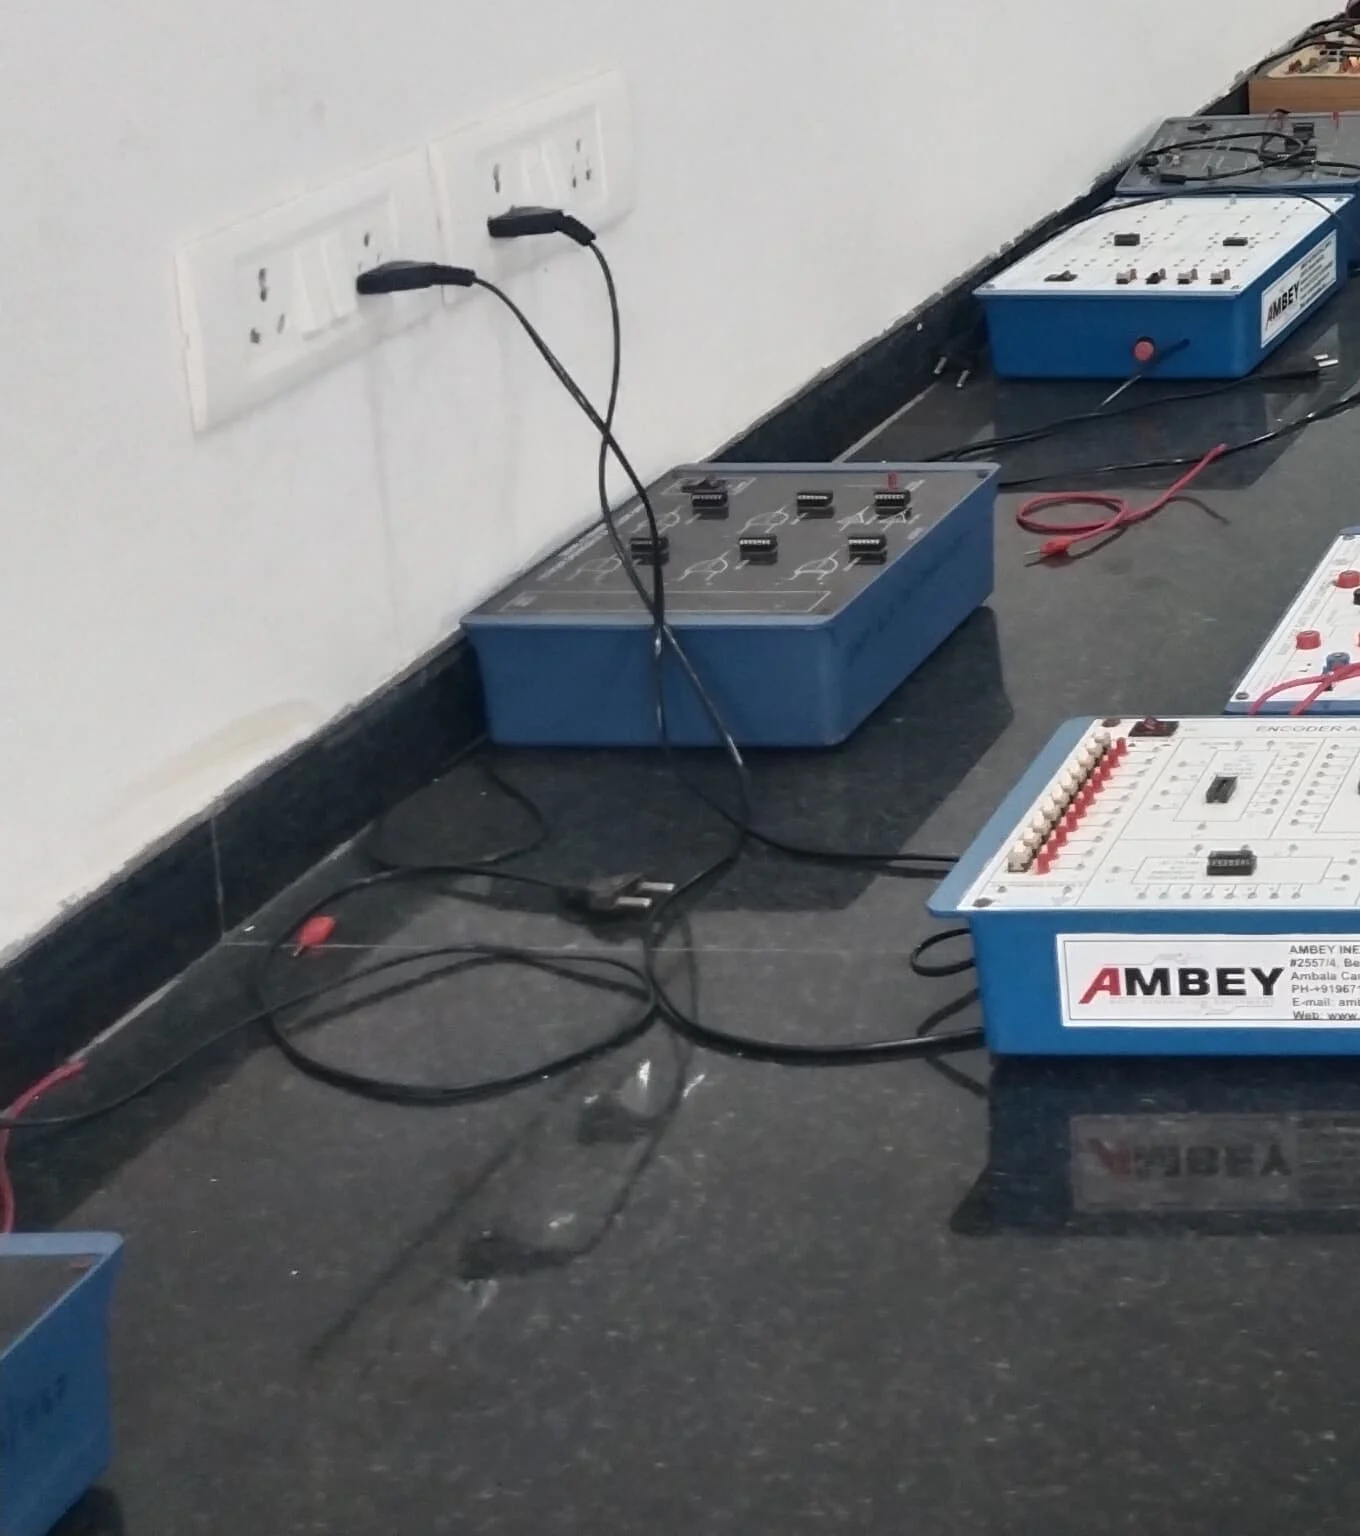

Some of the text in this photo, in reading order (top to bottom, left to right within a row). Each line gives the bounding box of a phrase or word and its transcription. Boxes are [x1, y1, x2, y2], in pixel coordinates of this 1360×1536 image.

[1265, 280, 1300, 331] AMBEY
[1255, 724, 1342, 733] ENCODER
[1289, 944, 1336, 955] AMBEY
[1290, 971, 1337, 981] Ambala
[1078, 967, 1285, 1005] AMBEY
